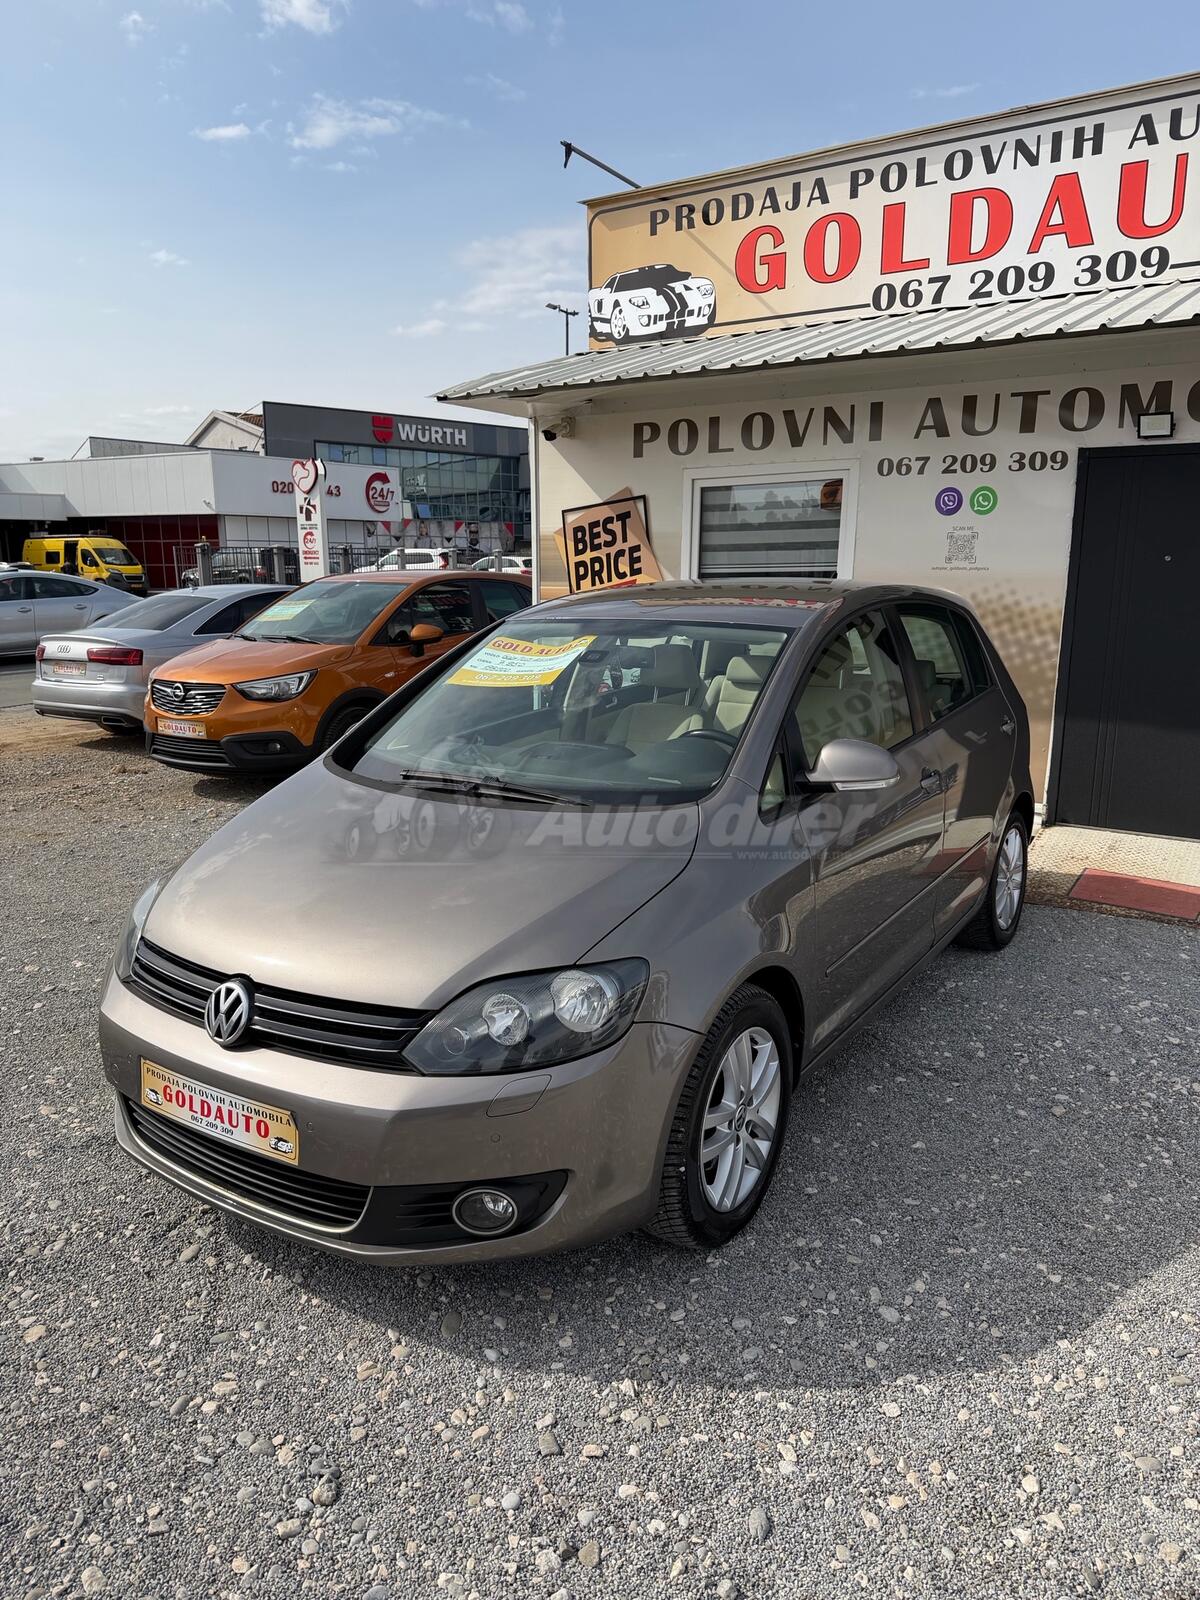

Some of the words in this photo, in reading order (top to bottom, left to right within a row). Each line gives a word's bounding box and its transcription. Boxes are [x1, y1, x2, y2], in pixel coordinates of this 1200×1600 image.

[650, 177, 830, 237] PRODAJA
[849, 122, 1105, 200] POLOVNIH
[735, 152, 1190, 294] GOLDAU
[872, 275, 951, 311] 067
[968, 261, 1055, 300] 209
[1073, 246, 1170, 288] 309
[632, 401, 884, 459] POLOVNI
[914, 380, 1200, 440] AUTOM
[877, 456, 931, 477] 067
[941, 453, 997, 475] 209
[1008, 450, 1069, 472] 309
[271, 480, 295, 495] 020
[370, 486, 395, 501] 24/7
[572, 510, 632, 557] BEST
[574, 544, 642, 591] PRICE
[491, 639, 534, 654] GOLD
[163, 723, 197, 734] GOLDAUTO
[146, 1067, 181, 1088] PRODAJA
[182, 1082, 226, 1106] POLOVNIH
[228, 1099, 292, 1128] AUTOMOBILA
[162, 1084, 270, 1139] GOLDAUTO
[190, 1114, 203, 1124] 067
[205, 1121, 219, 1131] 209
[220, 1126, 234, 1136] 309
